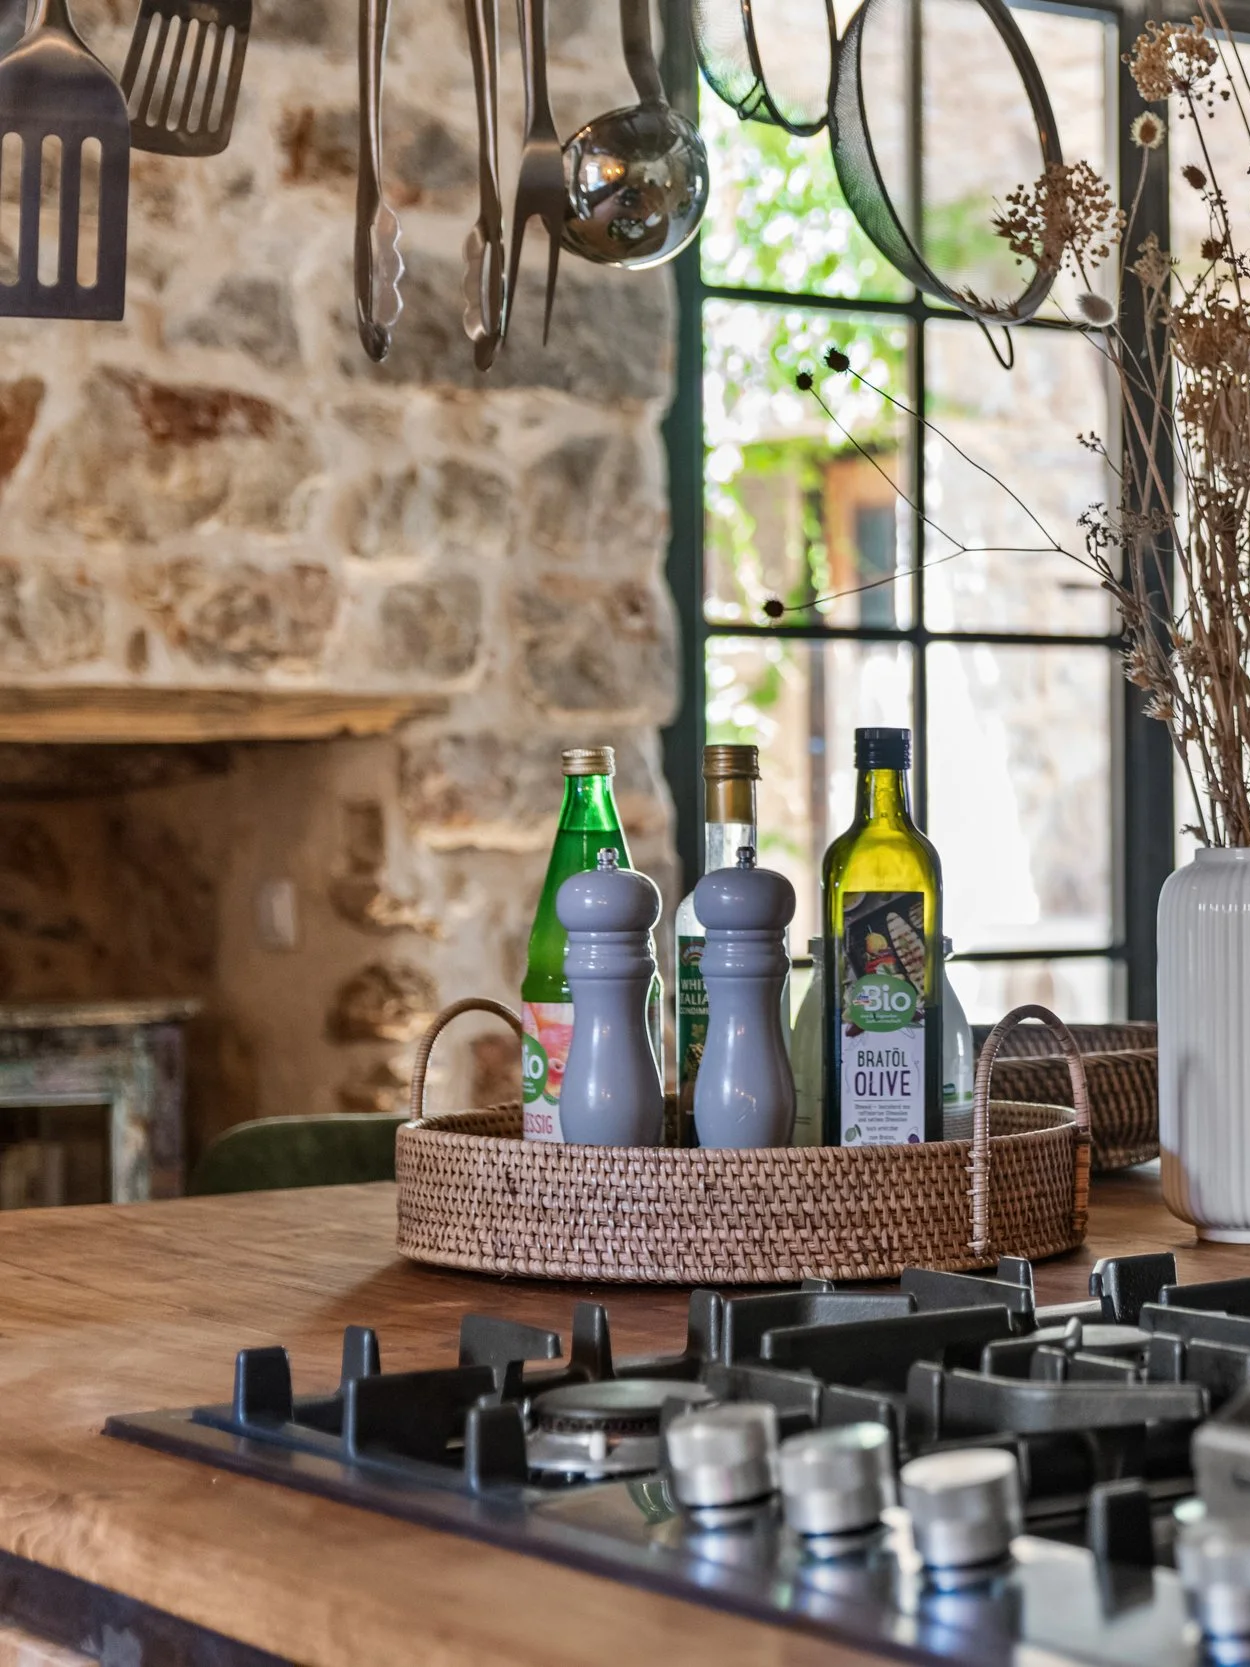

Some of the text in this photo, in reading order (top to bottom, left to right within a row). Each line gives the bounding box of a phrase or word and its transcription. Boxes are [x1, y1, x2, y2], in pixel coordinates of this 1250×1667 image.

[862, 984, 911, 1012] Bio
[522, 1045, 544, 1079] io
[858, 1047, 908, 1067] BRATÖL
[855, 1070, 911, 1096] OLIVE
